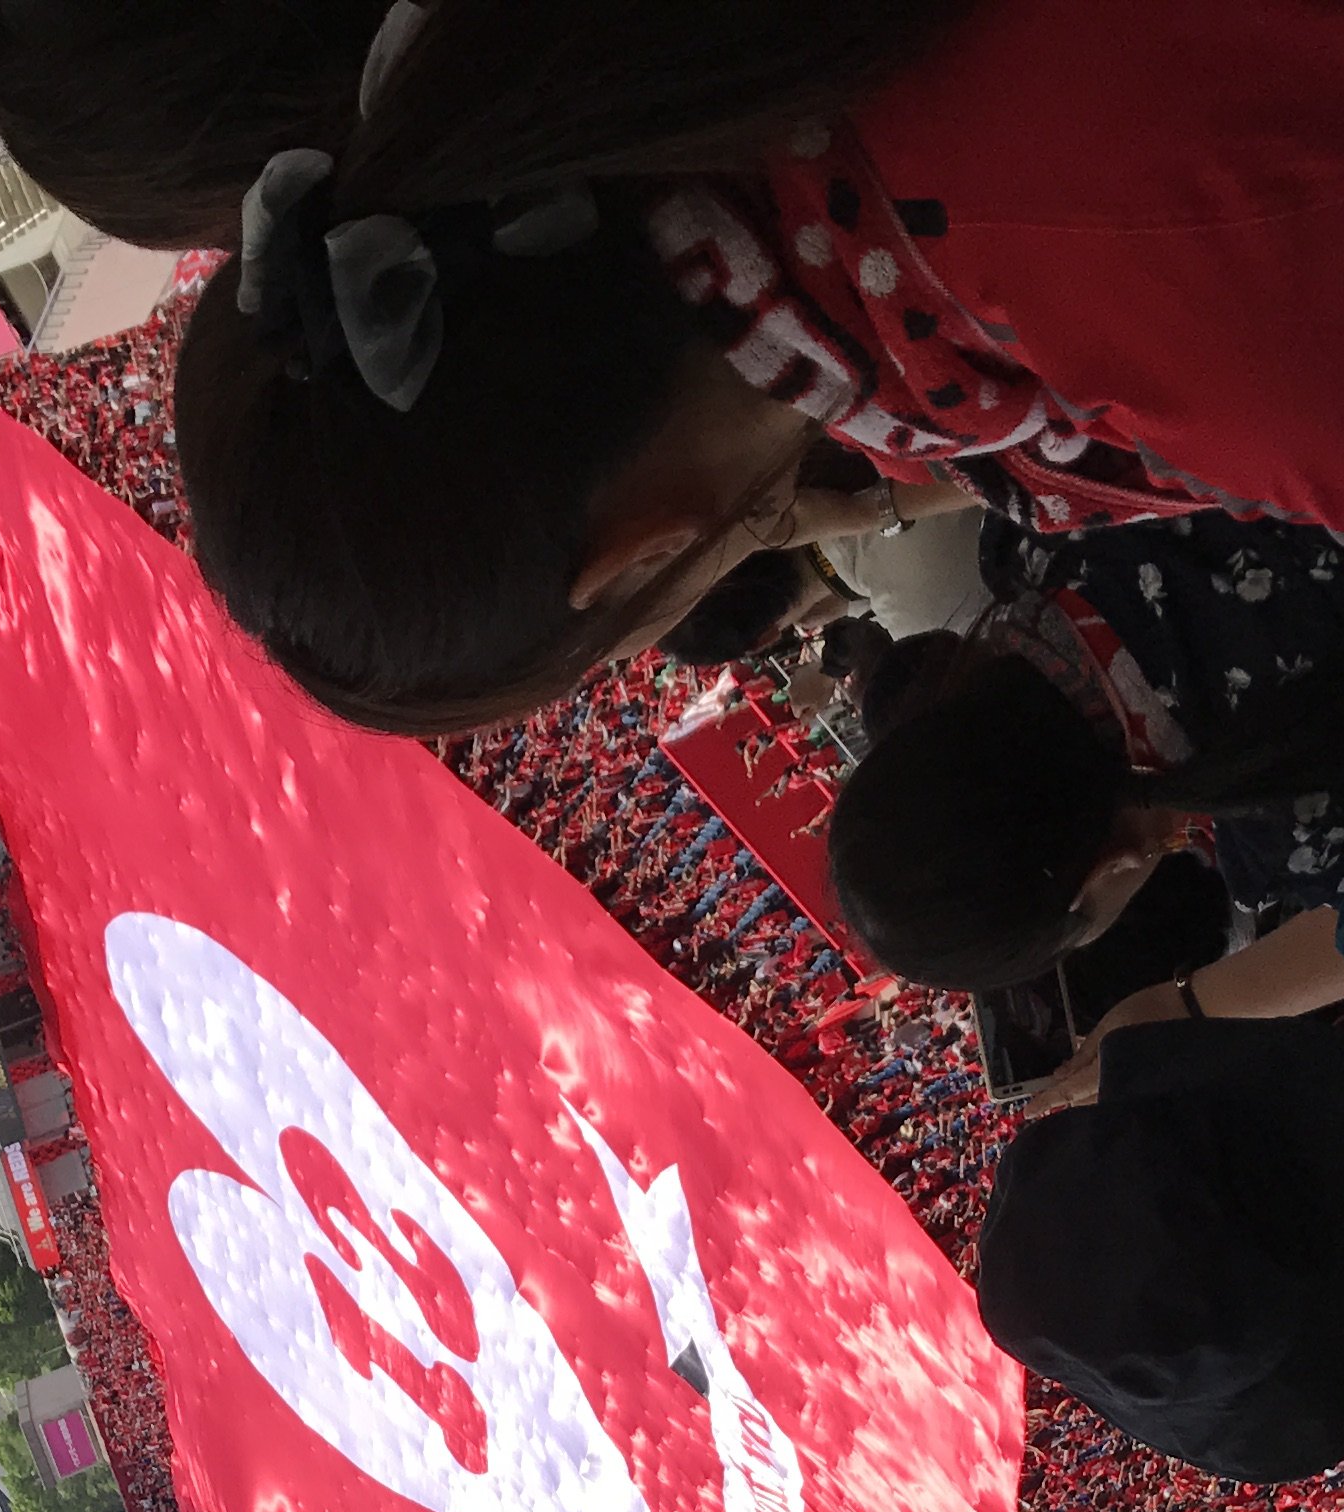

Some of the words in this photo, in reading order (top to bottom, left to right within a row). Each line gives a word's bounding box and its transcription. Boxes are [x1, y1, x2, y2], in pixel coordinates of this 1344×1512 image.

[2, 1142, 32, 1182] REDS
[20, 1181, 38, 1205] are
[26, 1206, 47, 1234] We
[278, 1125, 489, 1475] 12
